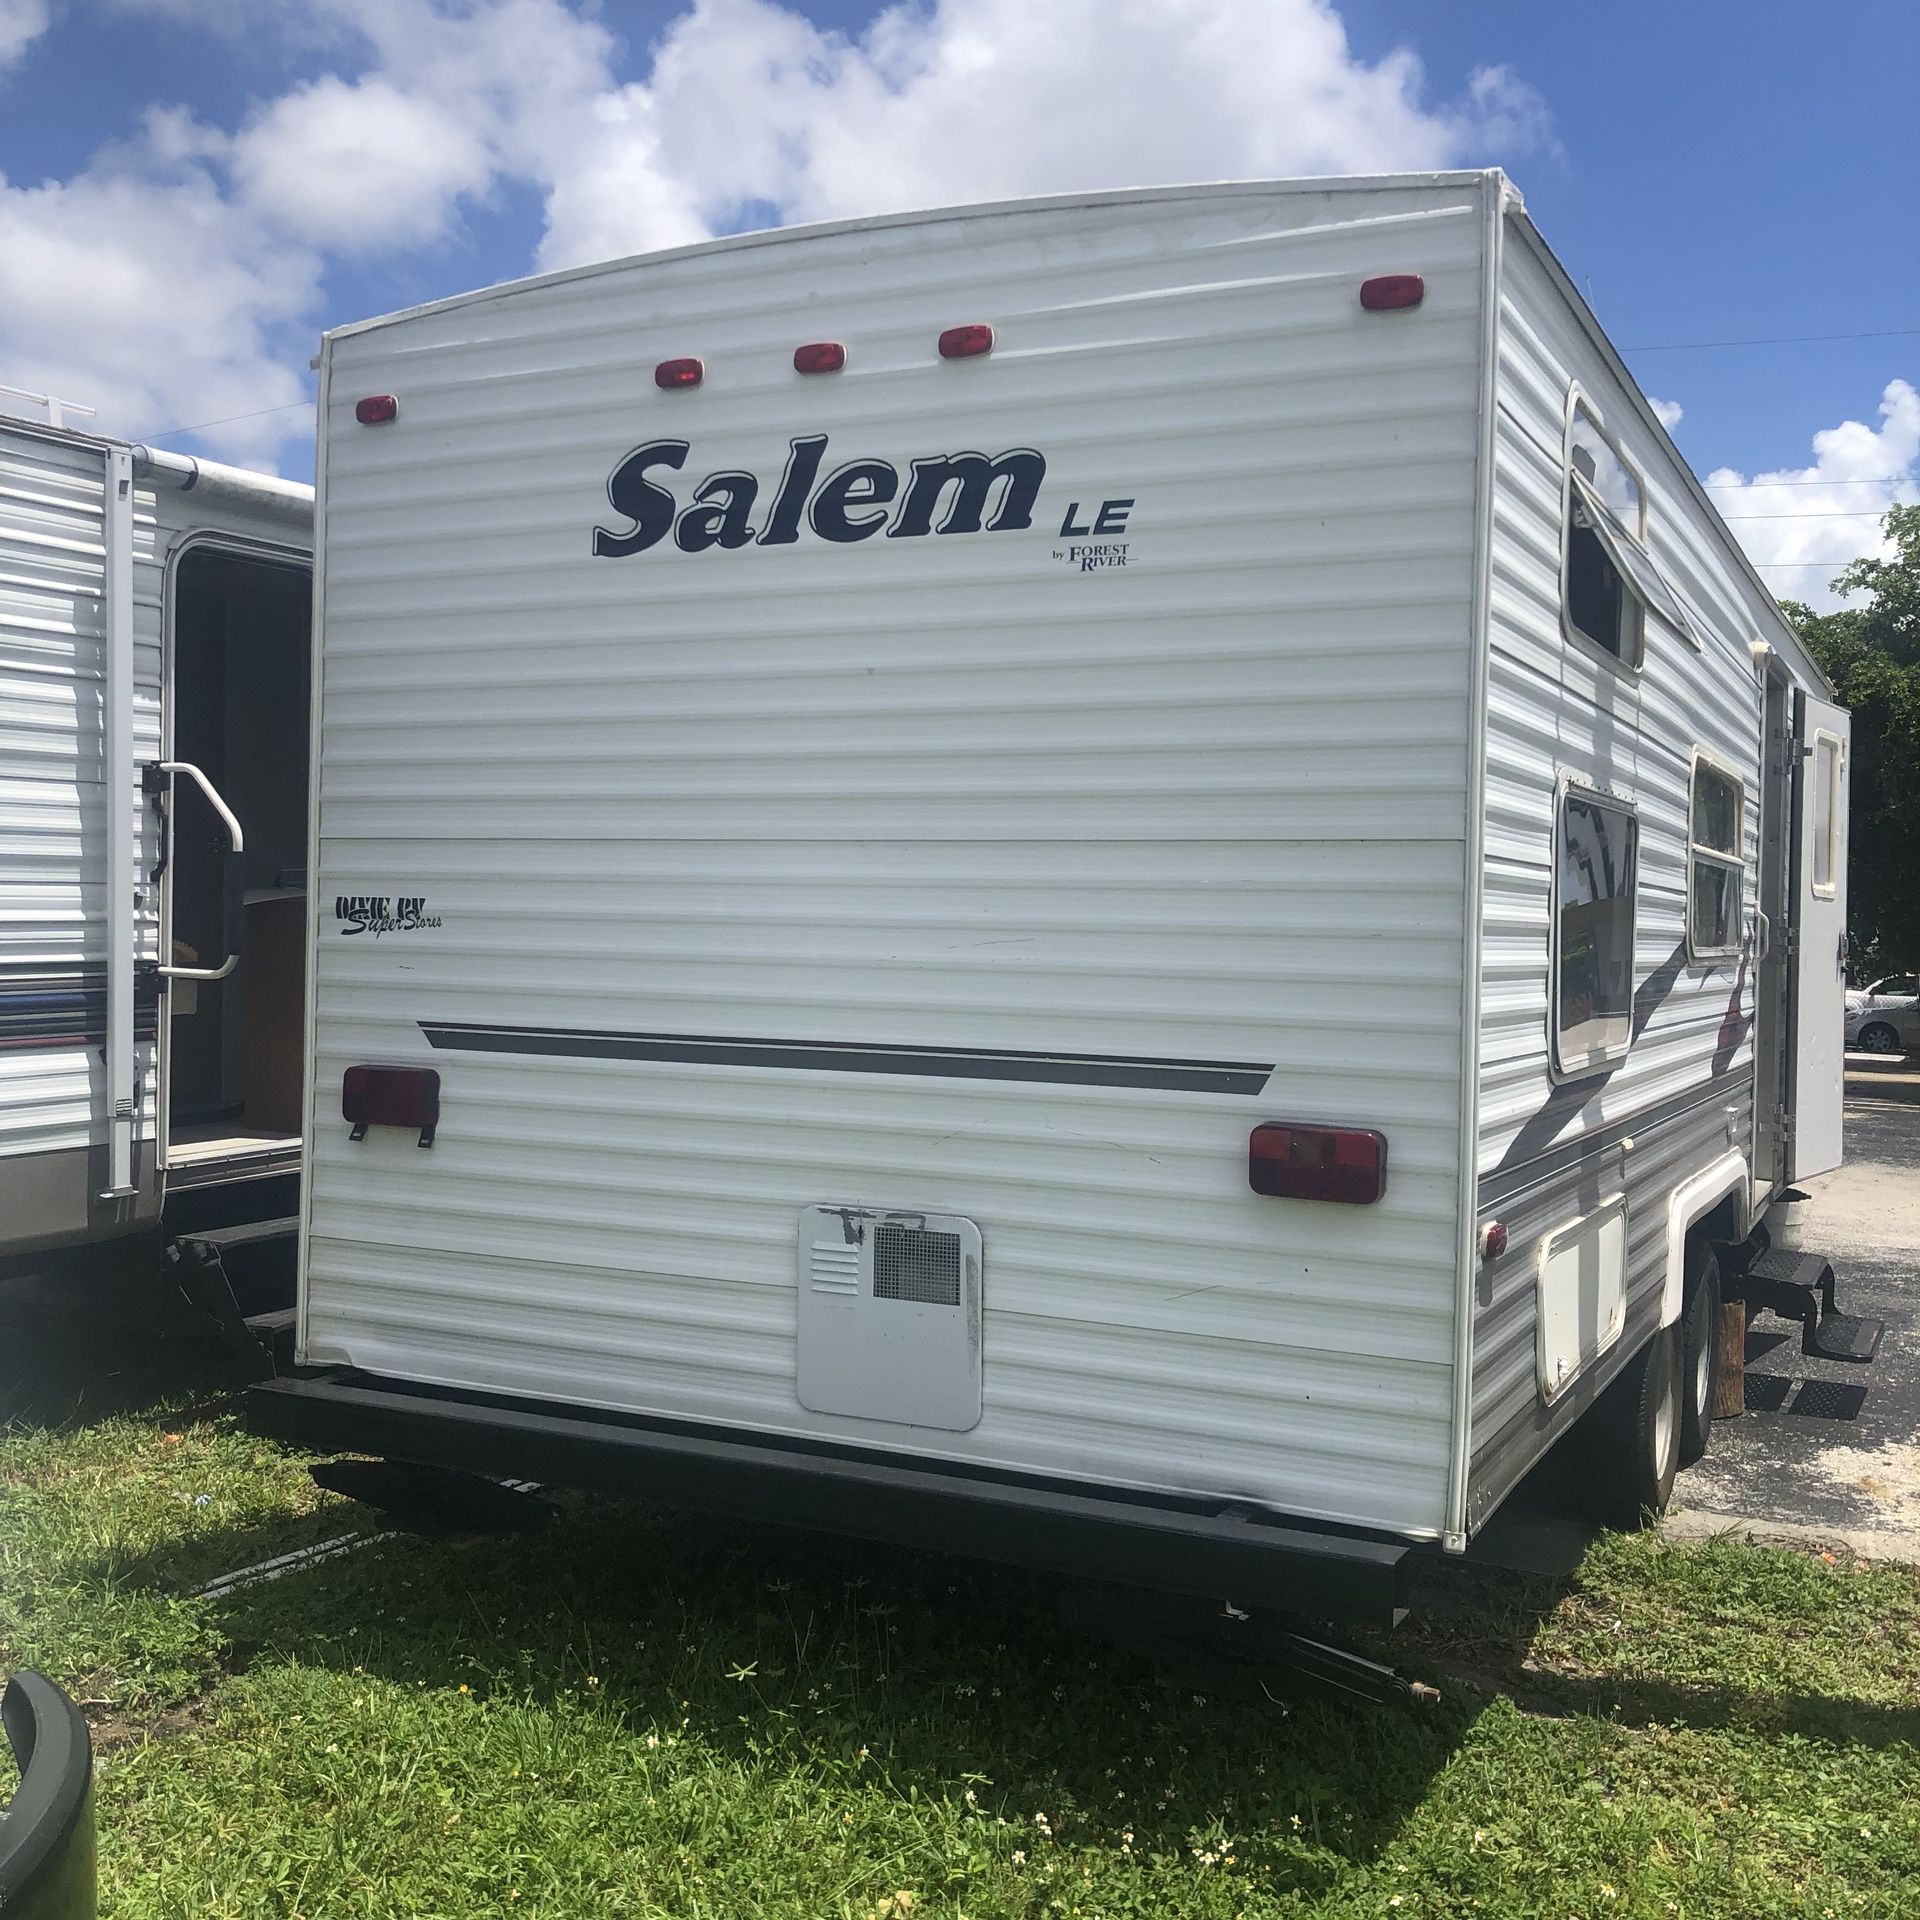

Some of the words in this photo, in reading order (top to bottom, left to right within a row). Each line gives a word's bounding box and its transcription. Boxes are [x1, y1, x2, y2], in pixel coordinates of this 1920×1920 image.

[592, 434, 1047, 558] Salem
[1059, 498, 1135, 537] LE
[1052, 550, 1065, 561] by
[1069, 544, 1130, 562] FOREST
[1080, 556, 1127, 572] RIVER
